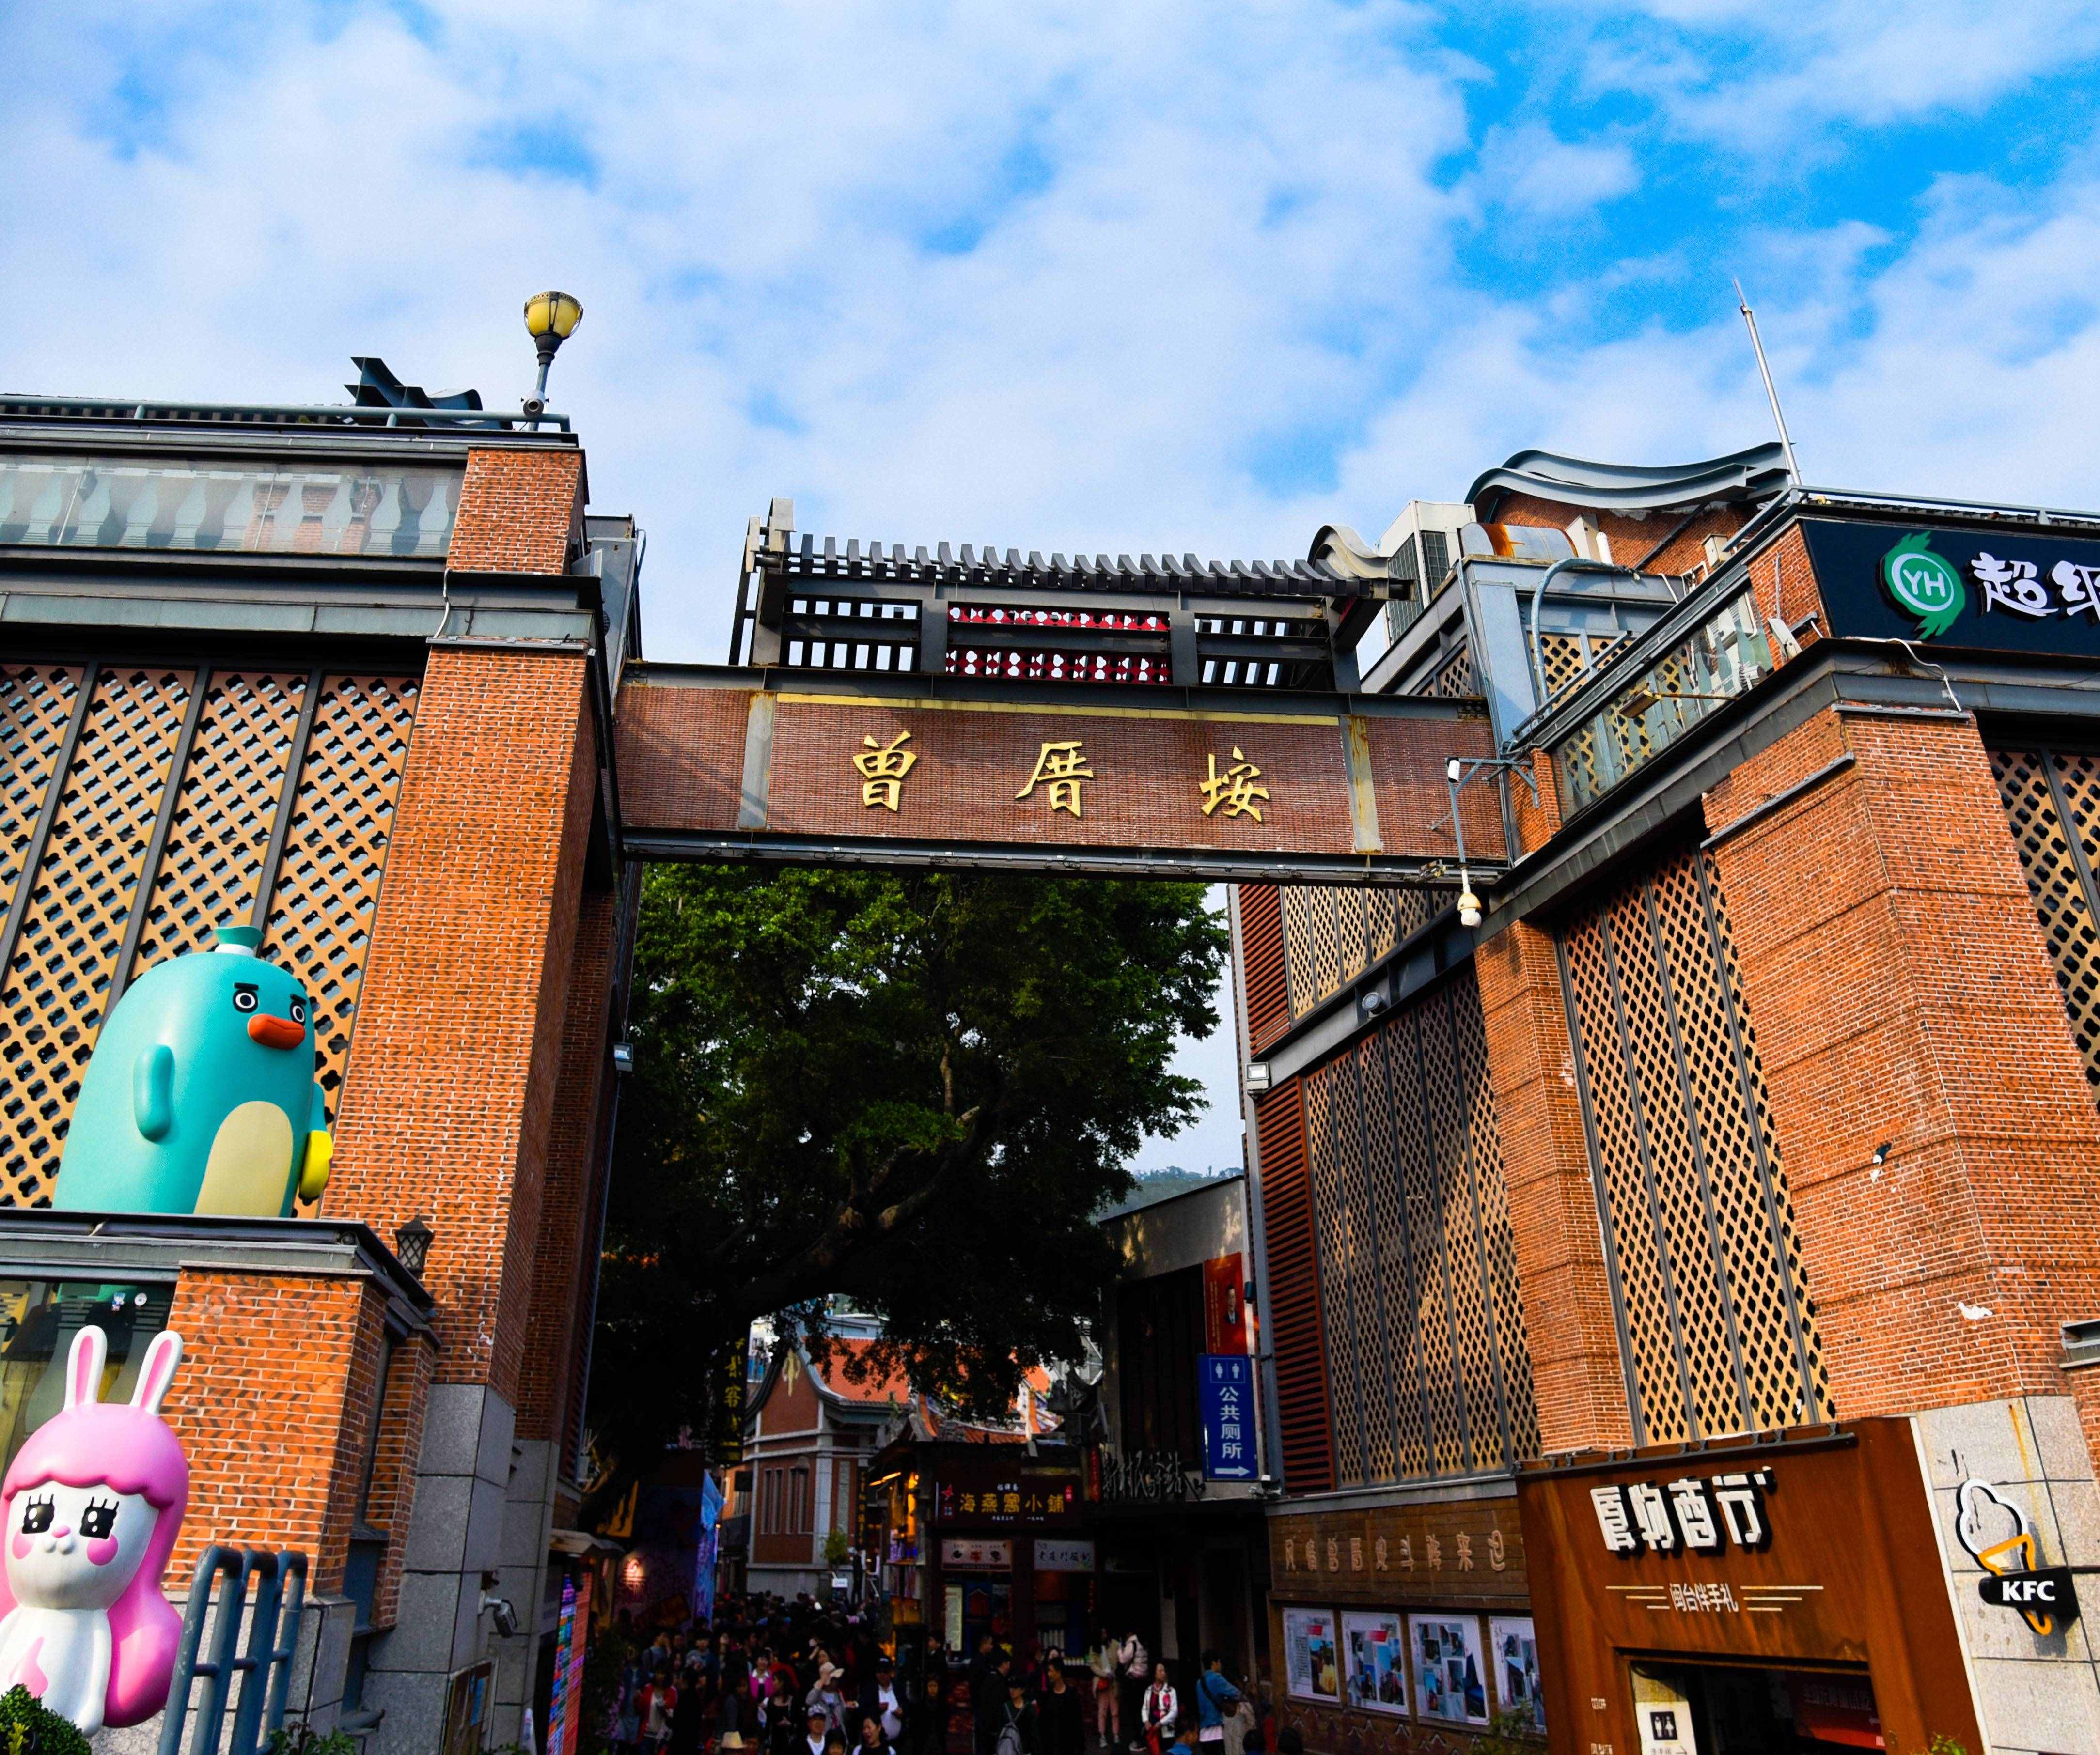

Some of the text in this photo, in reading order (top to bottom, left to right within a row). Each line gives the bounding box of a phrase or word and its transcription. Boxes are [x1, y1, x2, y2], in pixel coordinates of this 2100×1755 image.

[1903, 569, 1946, 597] YH
[853, 730, 1269, 822] 曾厝垵
[1219, 1386, 1242, 1459] 公共厕所
[1669, 1582, 1739, 1612] 闽台伴手礼
[2002, 1581, 2056, 1601] KFC
